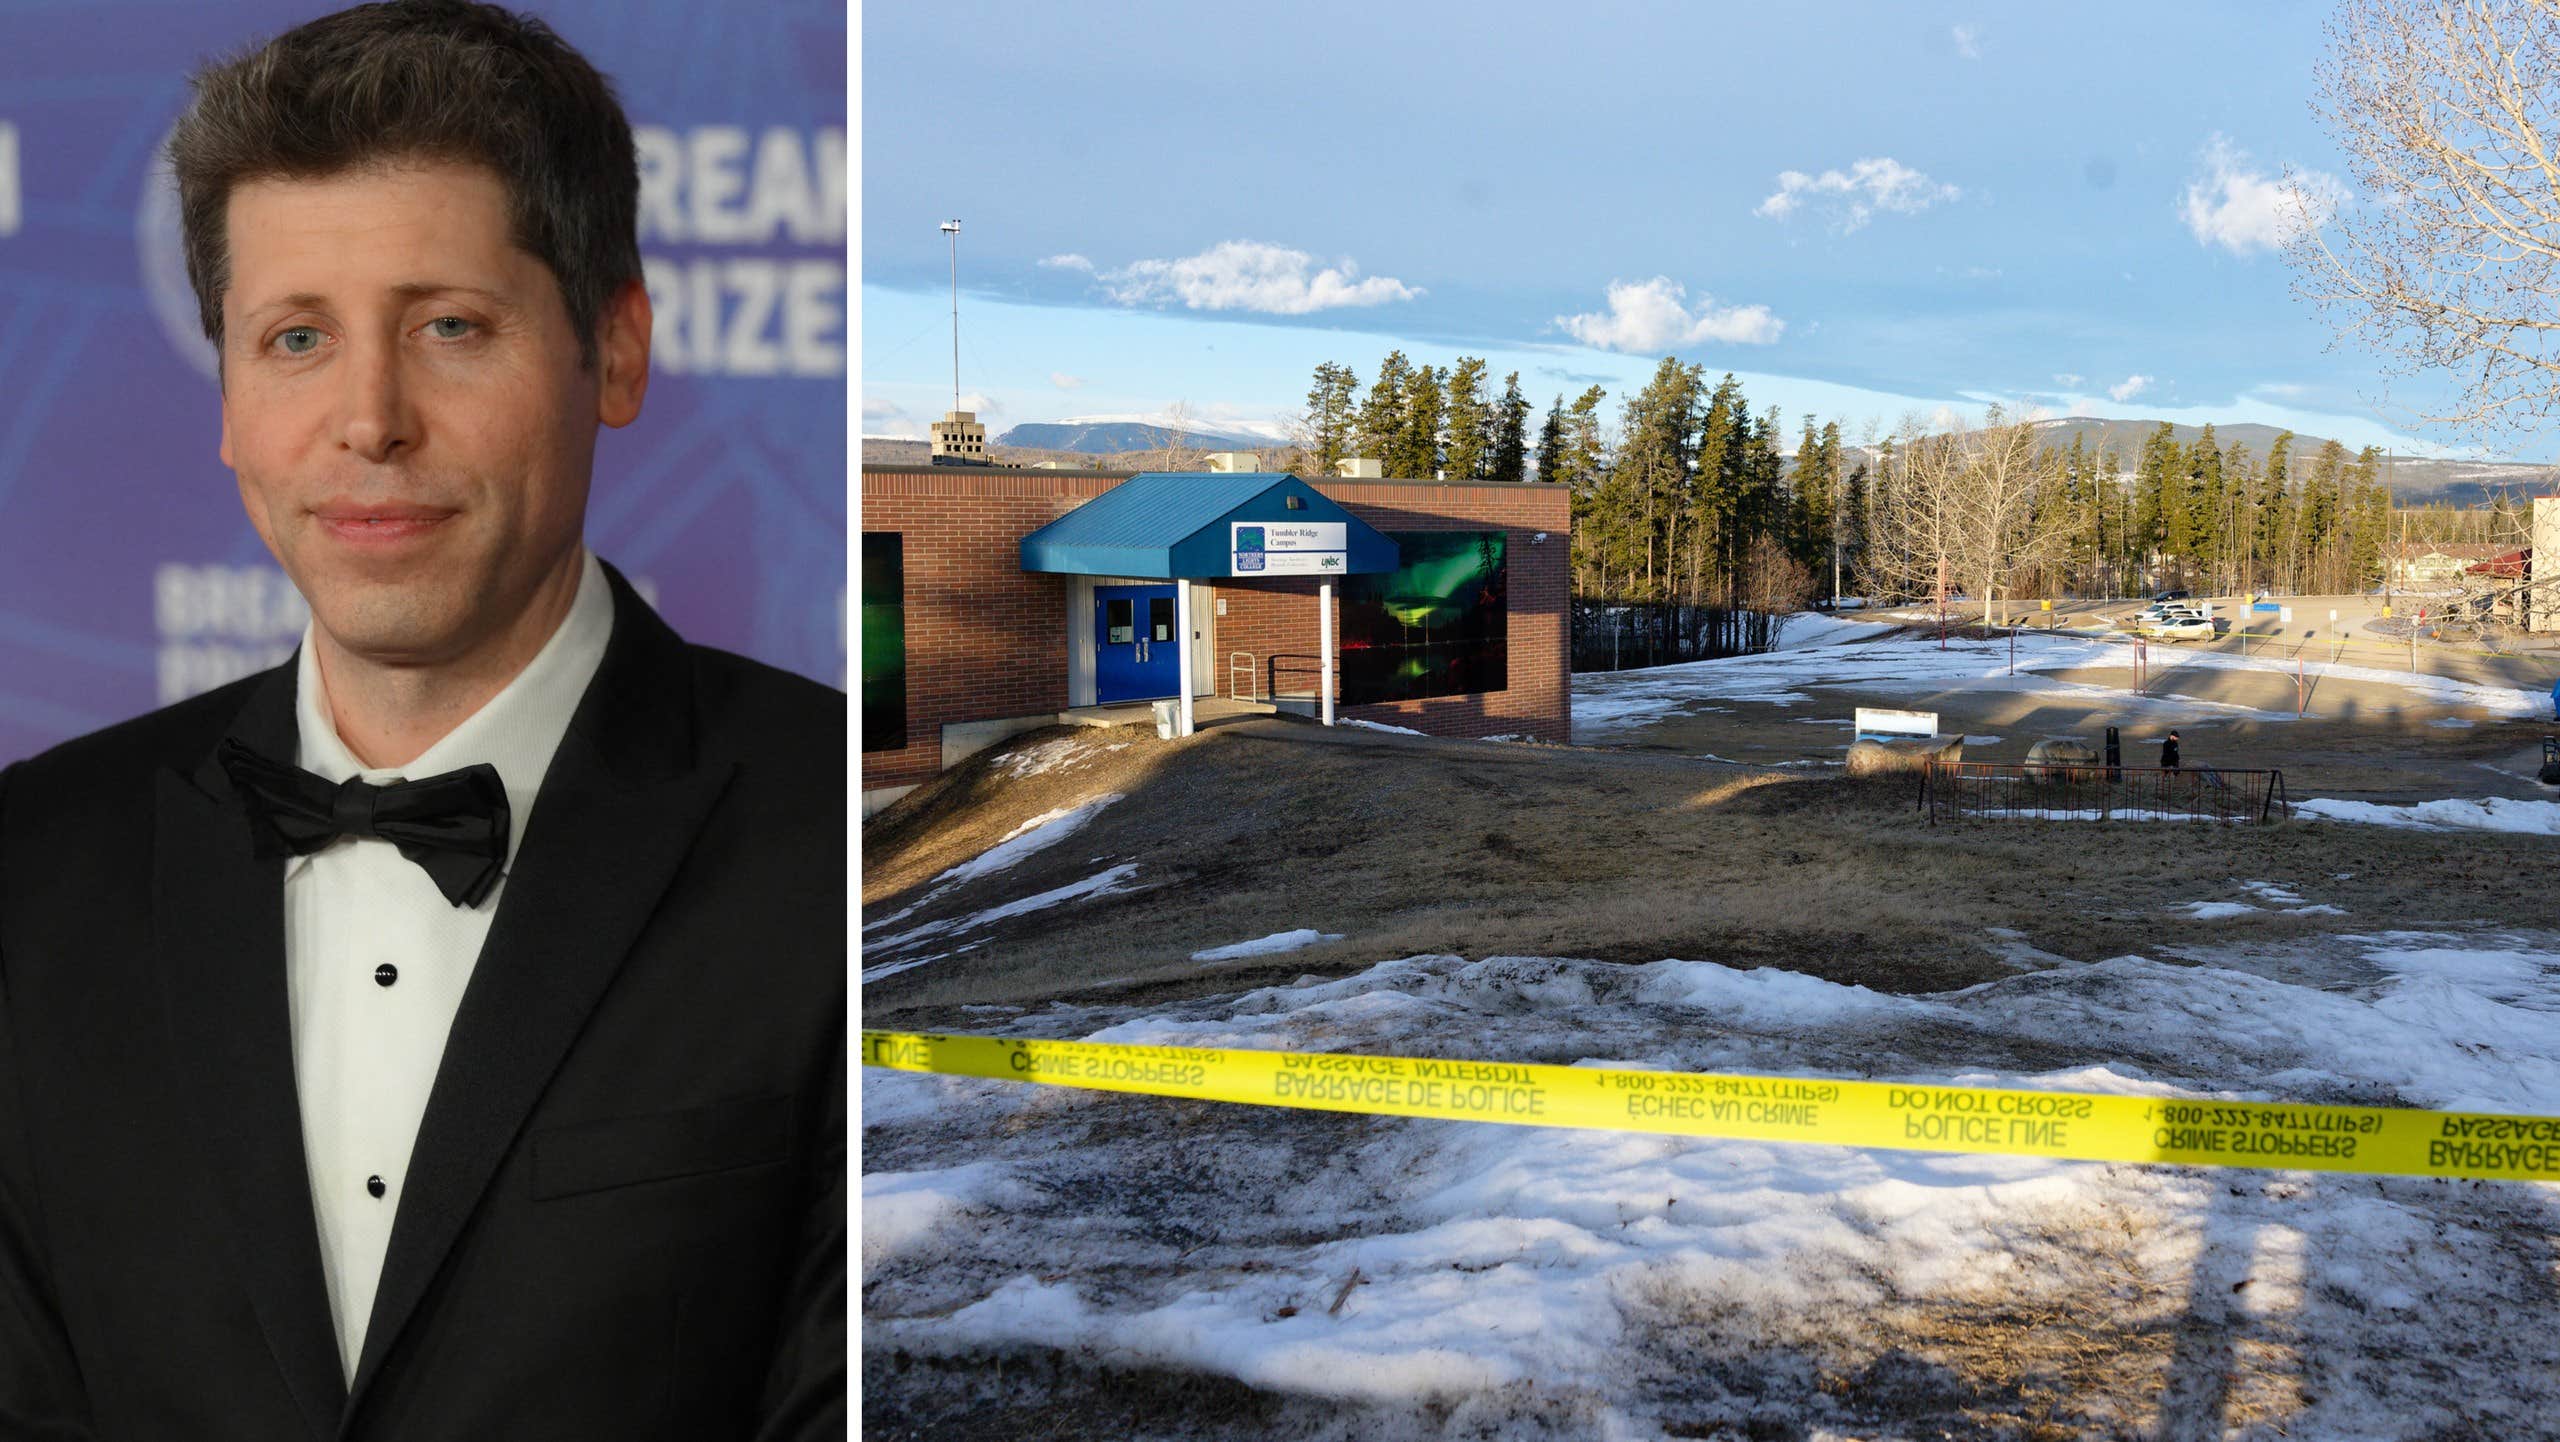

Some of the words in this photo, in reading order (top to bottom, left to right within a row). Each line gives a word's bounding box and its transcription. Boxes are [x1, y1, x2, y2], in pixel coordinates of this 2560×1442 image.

[1271, 529, 1298, 537] Tumbler
[1299, 528, 1319, 538] Ridge
[1270, 538, 1297, 549] Campus
